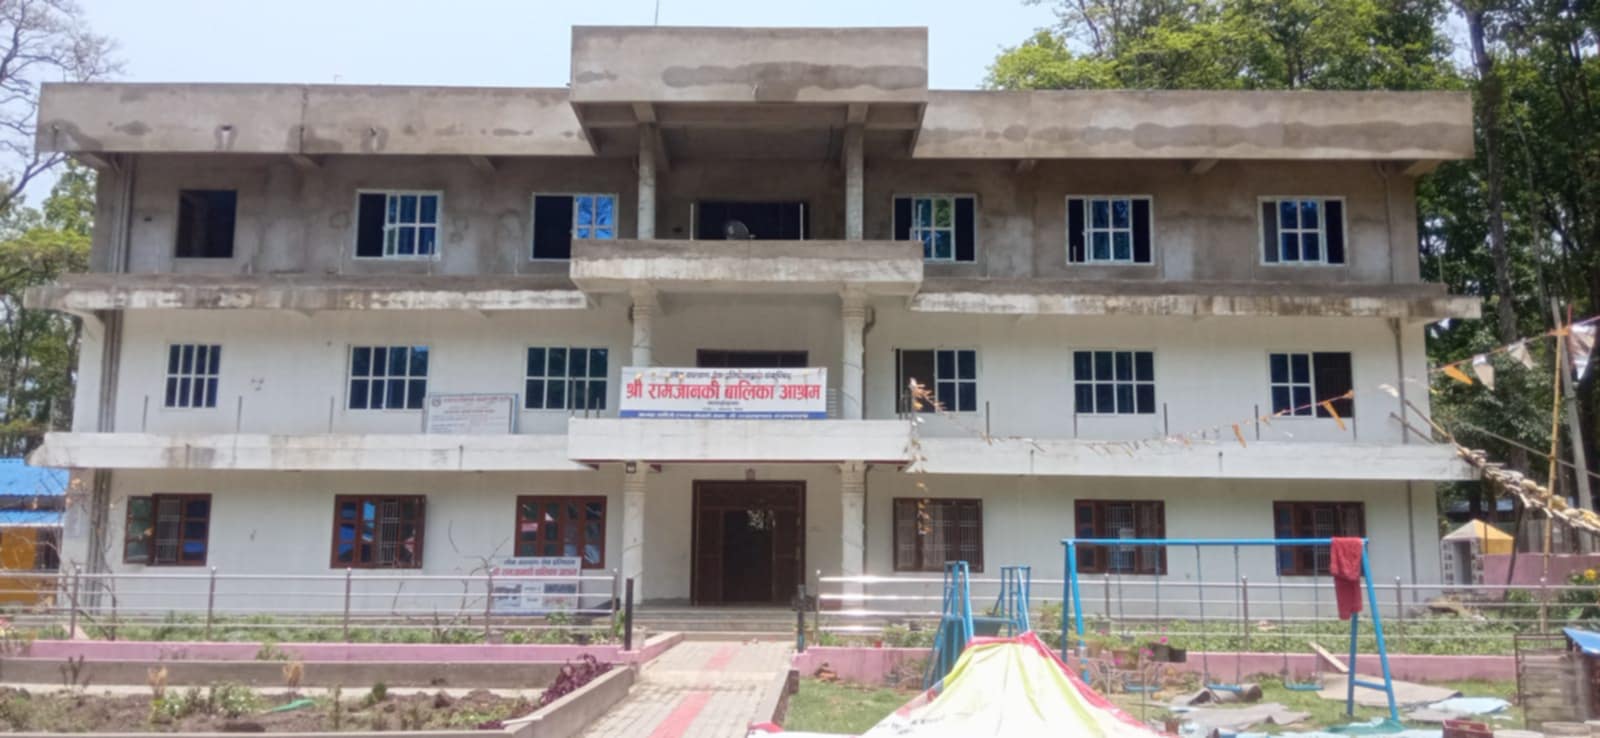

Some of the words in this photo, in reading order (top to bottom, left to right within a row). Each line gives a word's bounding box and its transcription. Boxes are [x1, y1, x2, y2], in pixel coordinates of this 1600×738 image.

[626, 377, 643, 399] श्री
[648, 377, 720, 400] रामजानकी
[724, 379, 775, 400] बालिका
[779, 383, 821, 400] आश्रम
